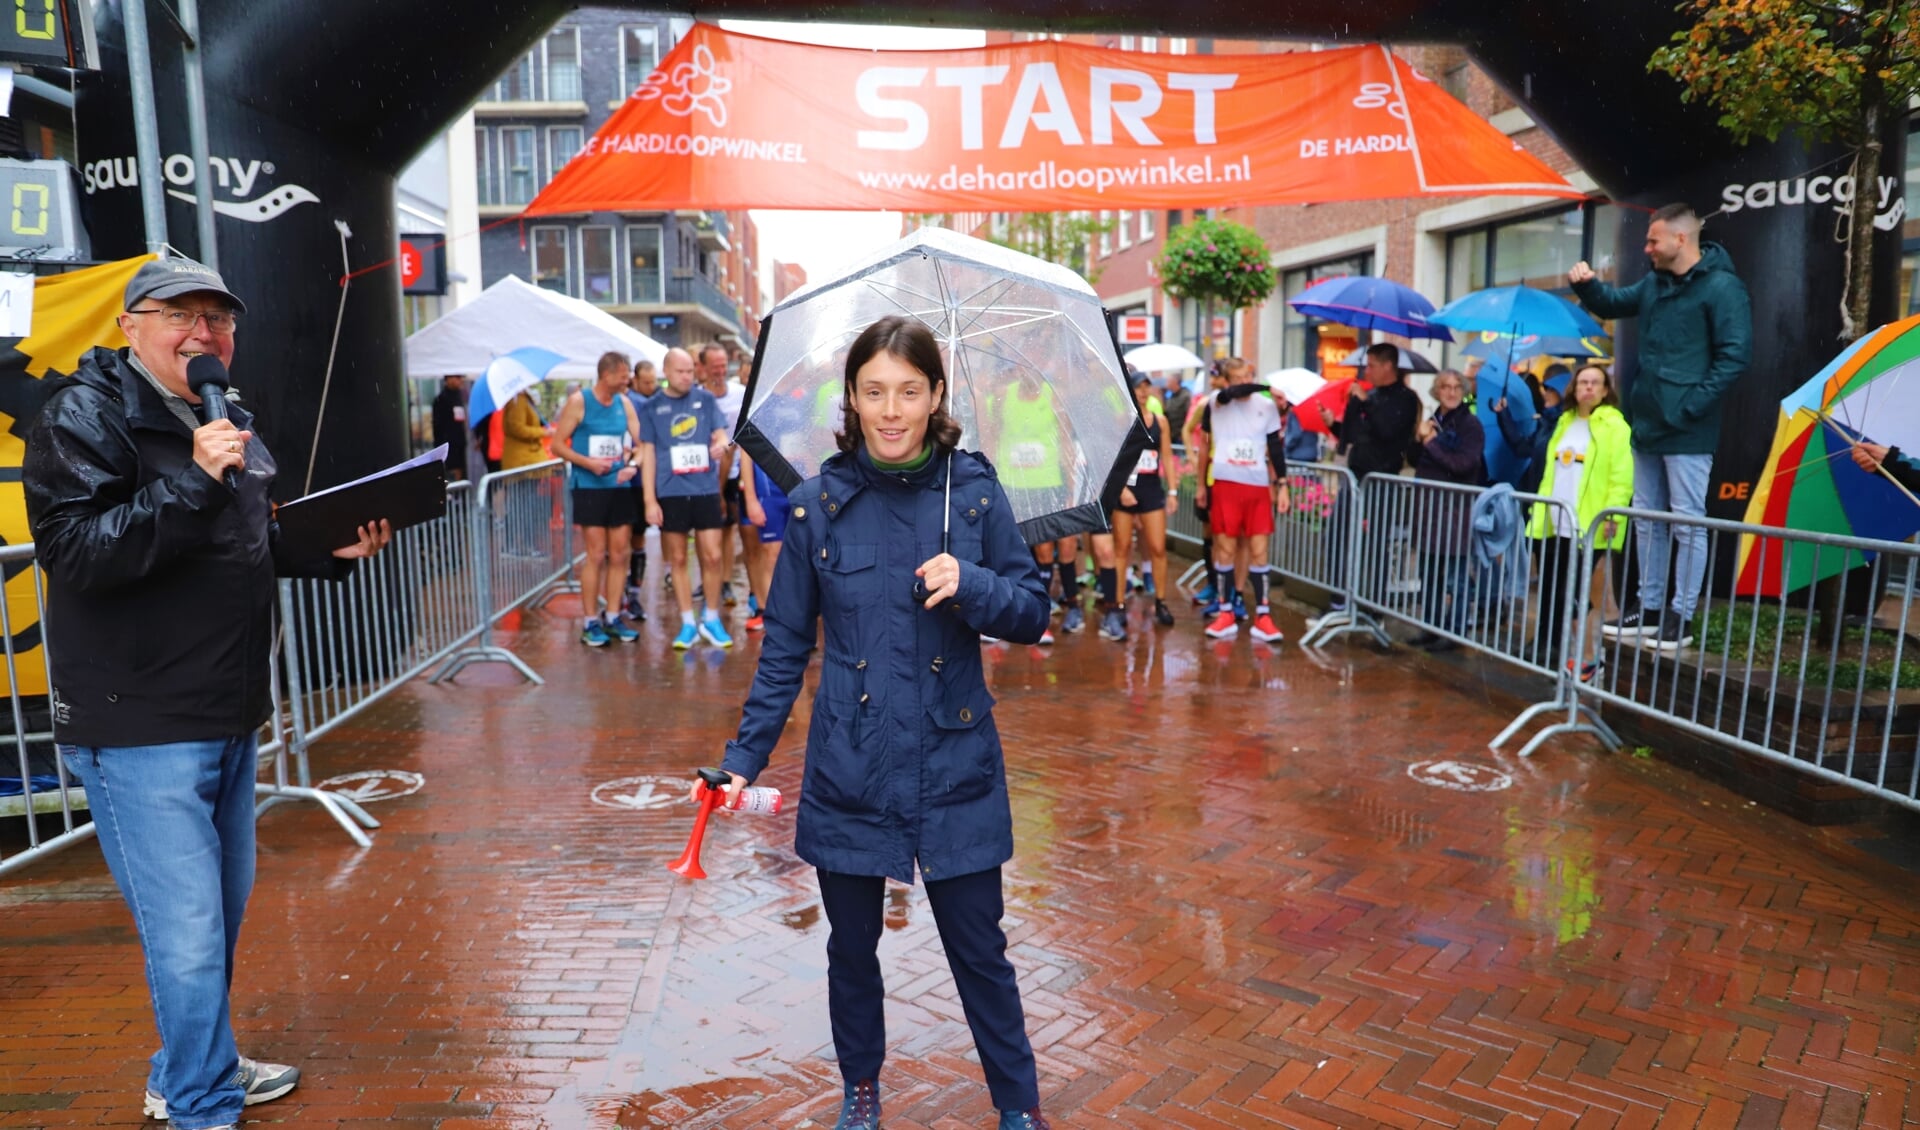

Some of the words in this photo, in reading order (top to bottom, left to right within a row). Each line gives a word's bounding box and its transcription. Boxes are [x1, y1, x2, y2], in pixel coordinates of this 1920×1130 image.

[855, 62, 1238, 151] START
[602, 134, 807, 163] HARDLOOPWINKEL
[1299, 139, 1328, 158] DE
[857, 155, 1251, 193] www.dehardloopwinkel.nl
[11, 183, 49, 236] 0
[1720, 174, 1894, 213] saucoy
[682, 454, 702, 467] 349
[1718, 482, 1750, 500] DE
